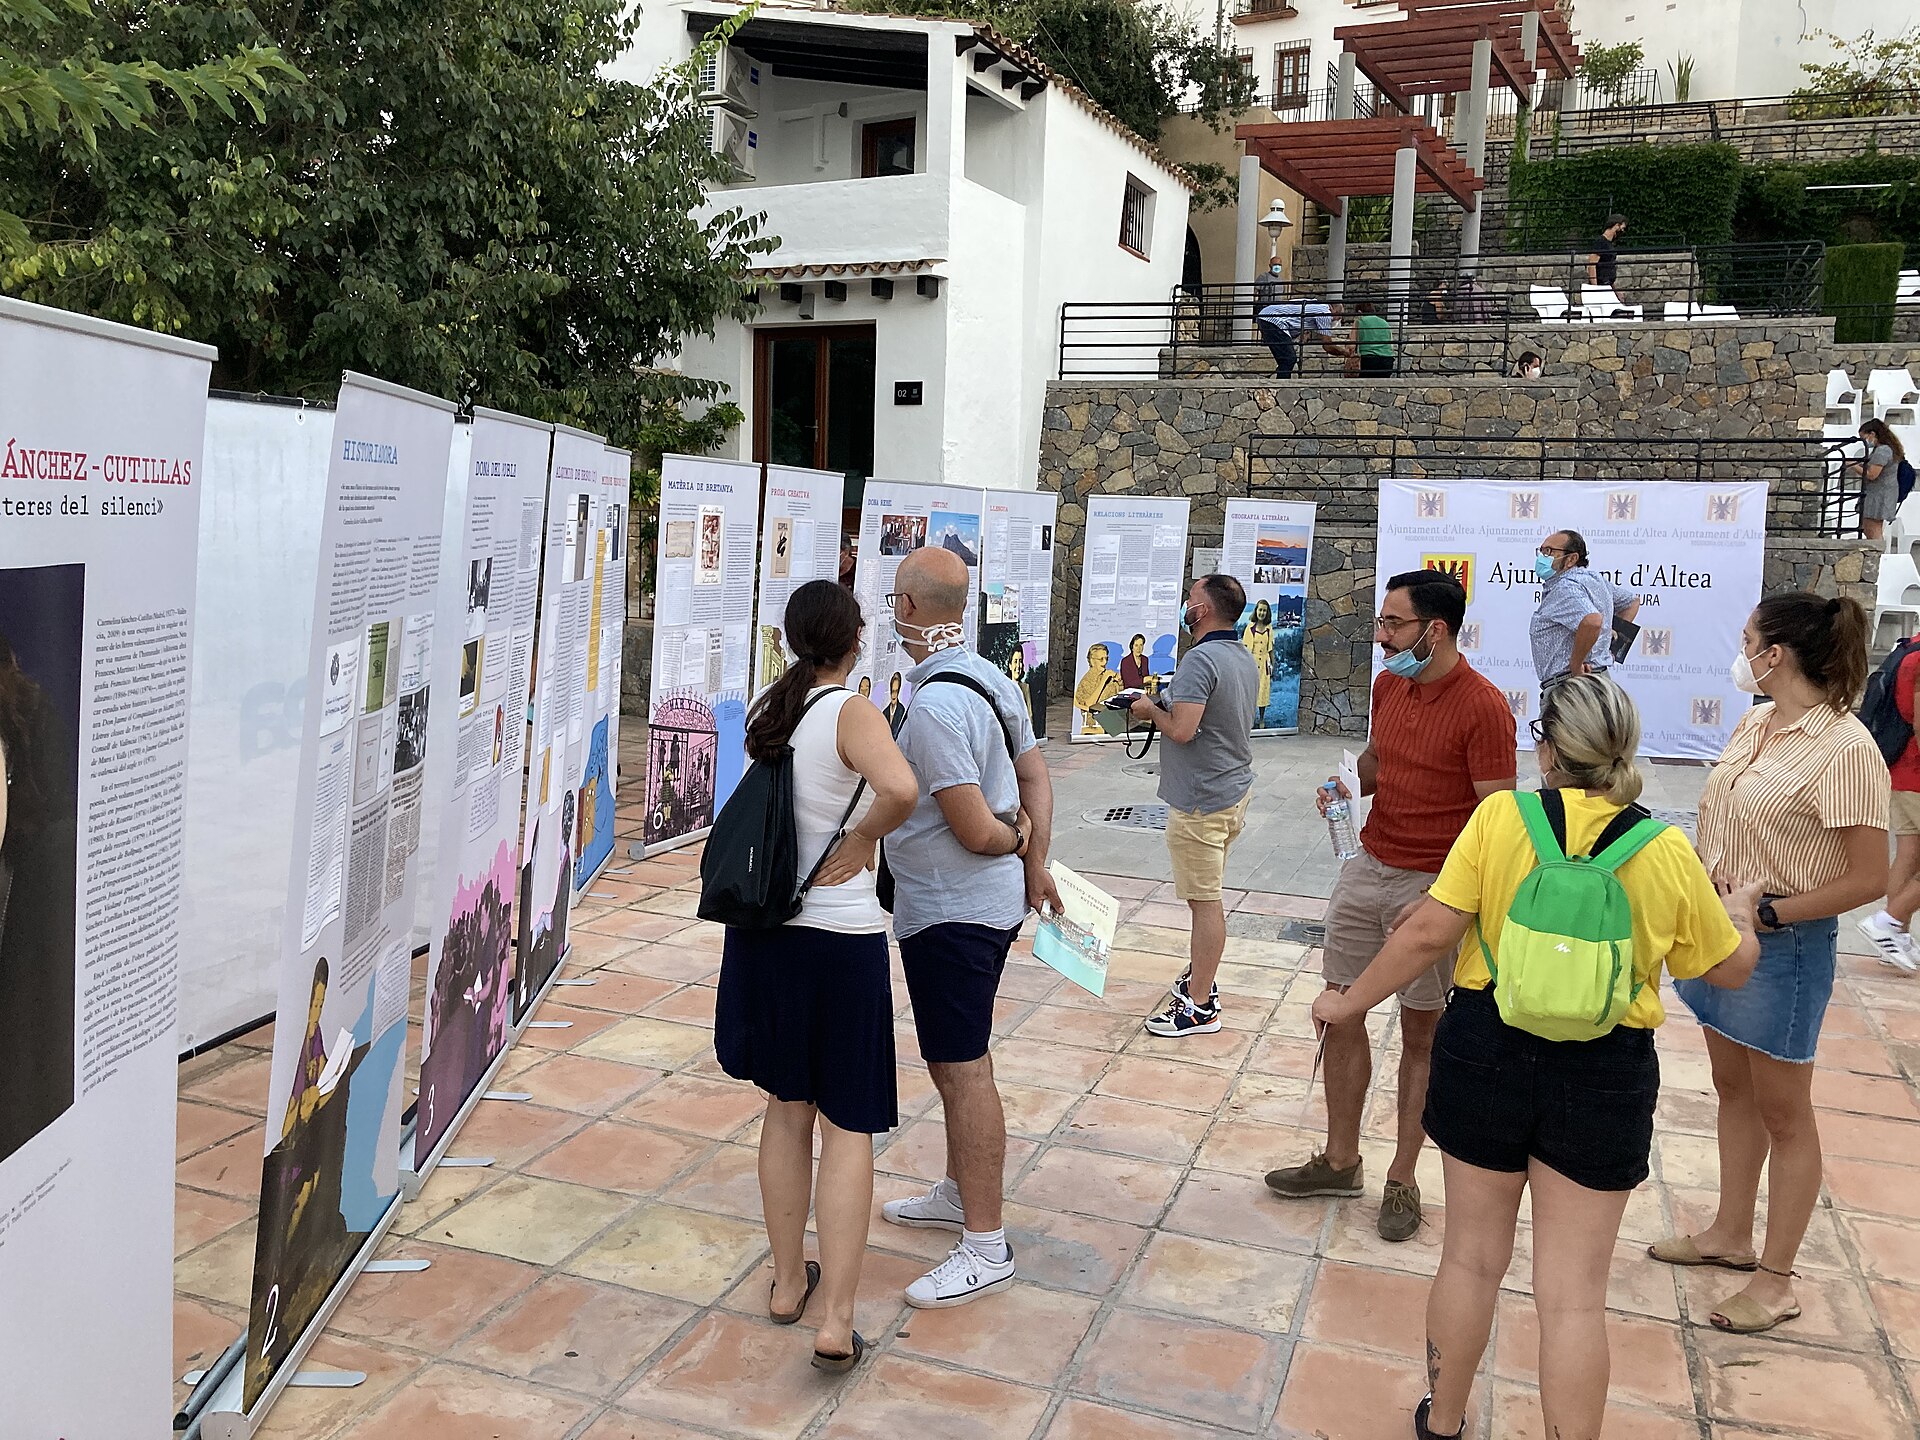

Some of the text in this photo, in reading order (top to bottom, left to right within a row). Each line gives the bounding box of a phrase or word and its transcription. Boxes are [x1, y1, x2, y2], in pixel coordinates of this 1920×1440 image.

[897, 389, 907, 398] 02
[1, 437, 192, 486] ÁNCHEZ-CUTILLAS
[668, 479, 694, 490] MATÈRIA
[697, 482, 704, 491] DE
[0, 494, 164, 516] teres del silenci»
[1128, 511, 1164, 519] LITERÀRIES
[1387, 524, 1440, 535] Ajuntament
[1442, 524, 1475, 535] d'Altea
[1478, 525, 1534, 536] Ajuntament
[1576, 526, 1630, 538] Ajuntament
[1633, 527, 1667, 538] d'Altea
[1671, 528, 1730, 540] Ajuntament
[1733, 528, 1763, 540] d'Alte
[1488, 561, 1712, 591] Ajunnt d'Altea
[1477, 657, 1510, 667] d'Altea
[1610, 663, 1665, 674] Ajuntament
[1668, 663, 1701, 674] d'Altea
[1660, 730, 1716, 743] Ajuntament
[653, 802, 663, 830] 6
[425, 1083, 435, 1136] 3
[260, 1284, 280, 1359] 2
